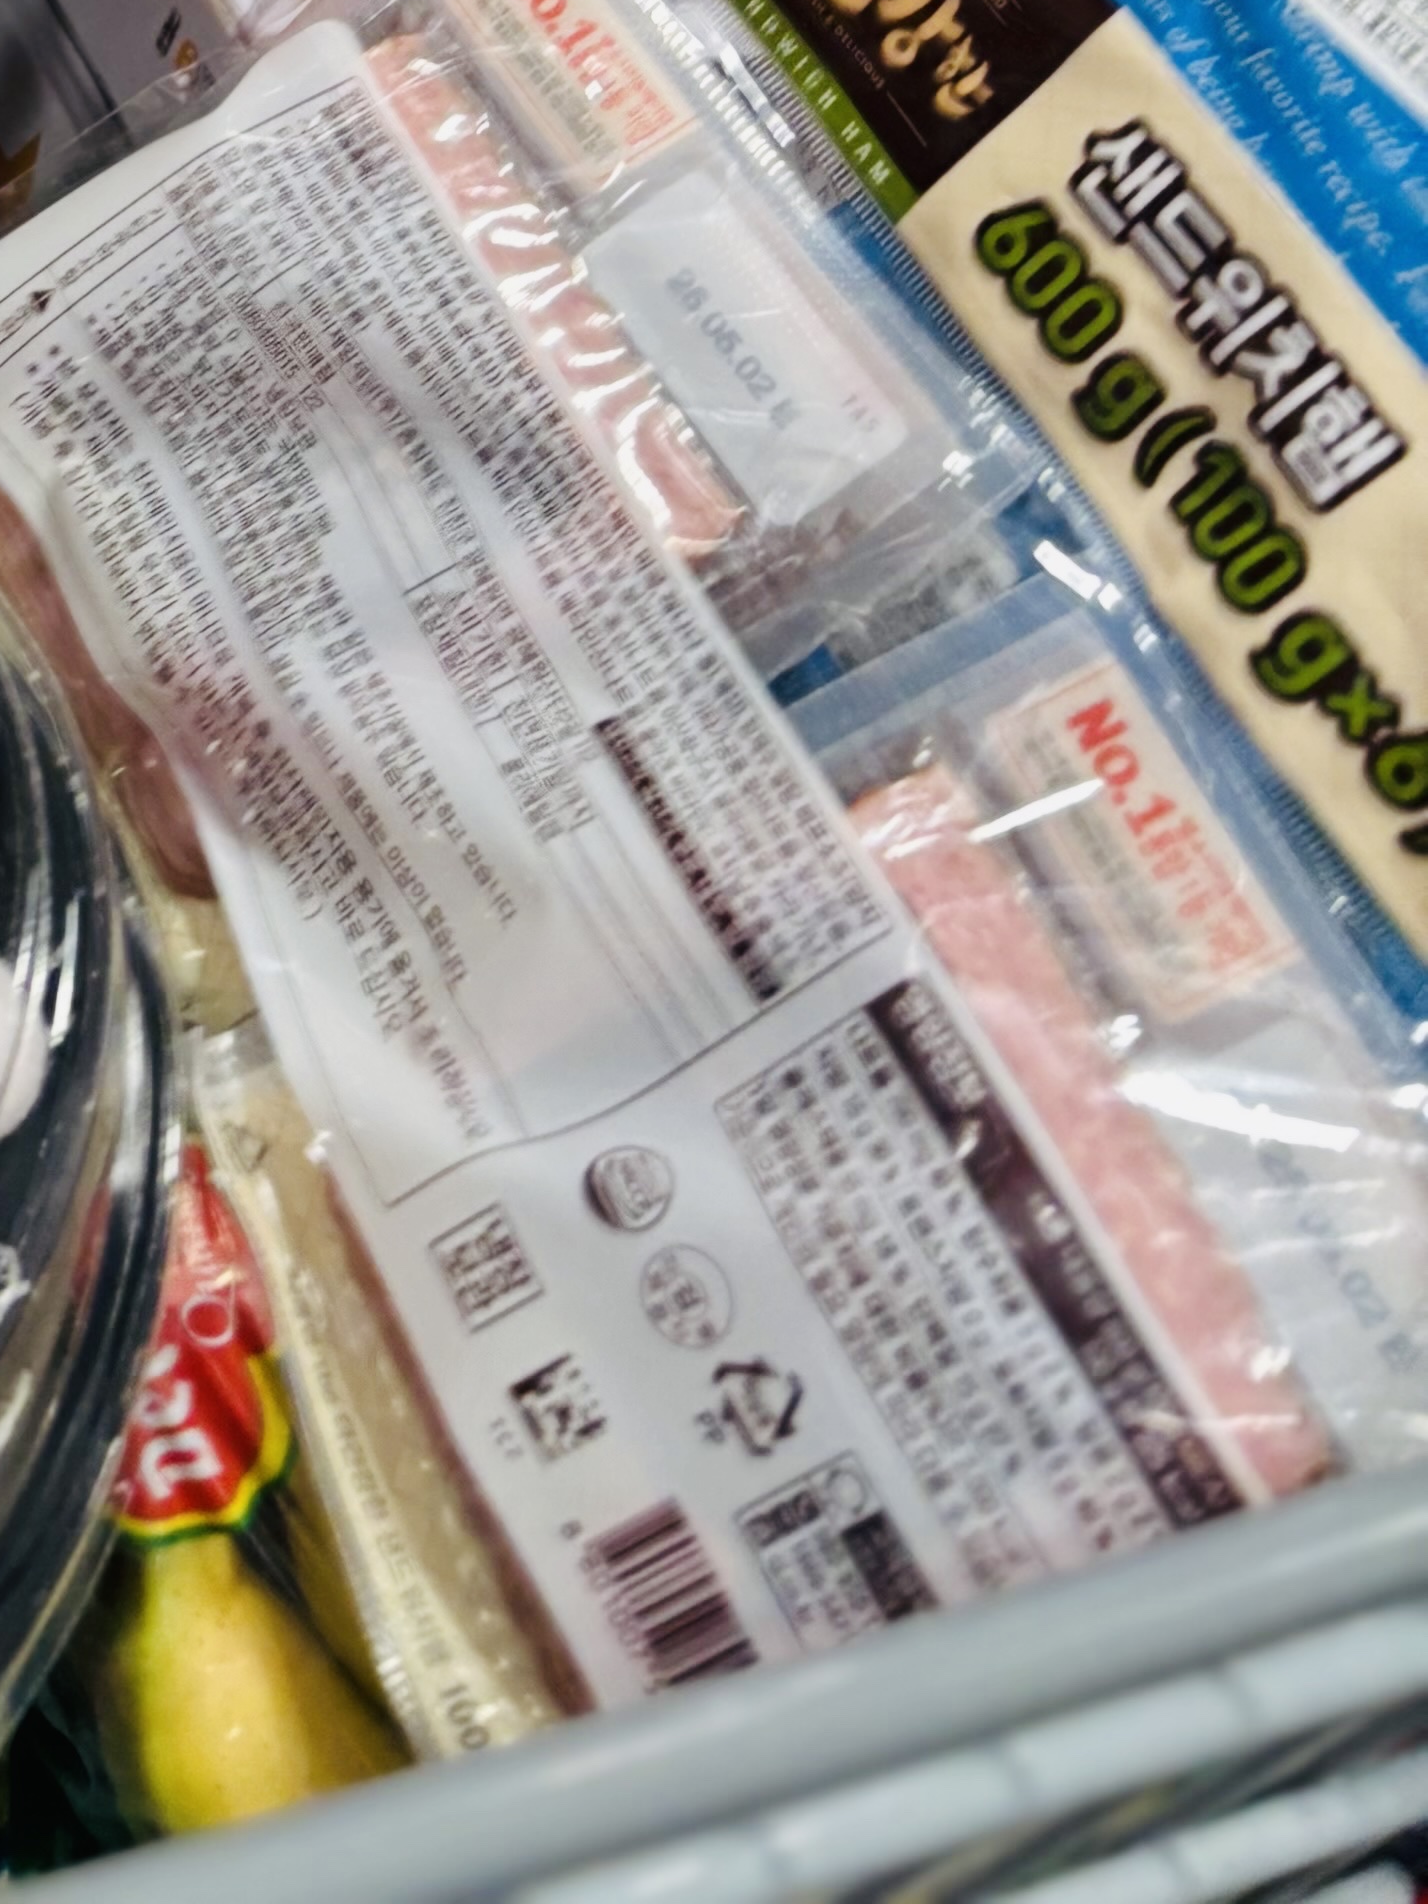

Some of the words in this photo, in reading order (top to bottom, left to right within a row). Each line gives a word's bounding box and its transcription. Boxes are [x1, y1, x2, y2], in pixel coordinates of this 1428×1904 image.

[1166, 13, 1208, 62] of
[837, 120, 895, 186] HAM
[1248, 40, 1328, 160] favorite
[1351, 94, 1410, 177] with
[971, 197, 1124, 365] 600
[1070, 111, 1411, 516] 샌드위치햄
[1054, 690, 1184, 840] No.1
